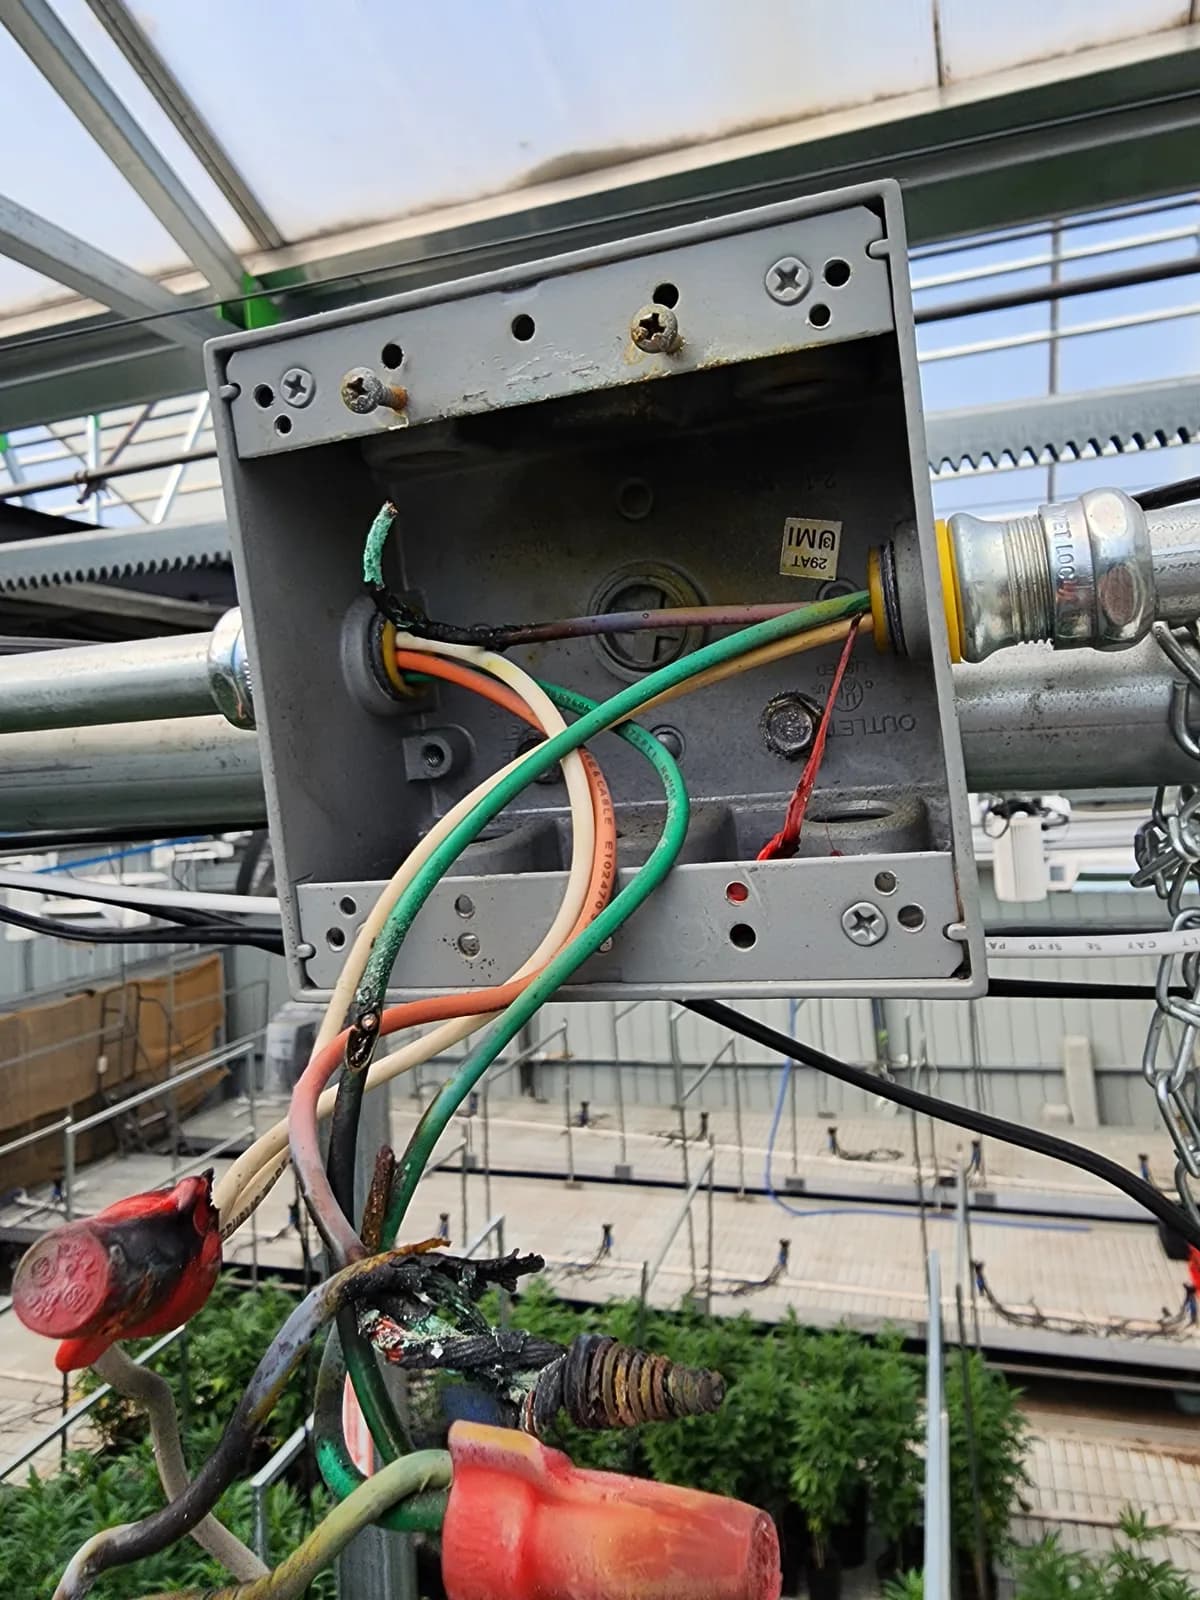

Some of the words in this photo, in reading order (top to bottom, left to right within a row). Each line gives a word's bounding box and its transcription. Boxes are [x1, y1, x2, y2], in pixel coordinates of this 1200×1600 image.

[791, 555, 828, 570] 29AT
[816, 661, 868, 676] LISED
[596, 780, 613, 826] CABLE
[595, 841, 614, 910] E102470
